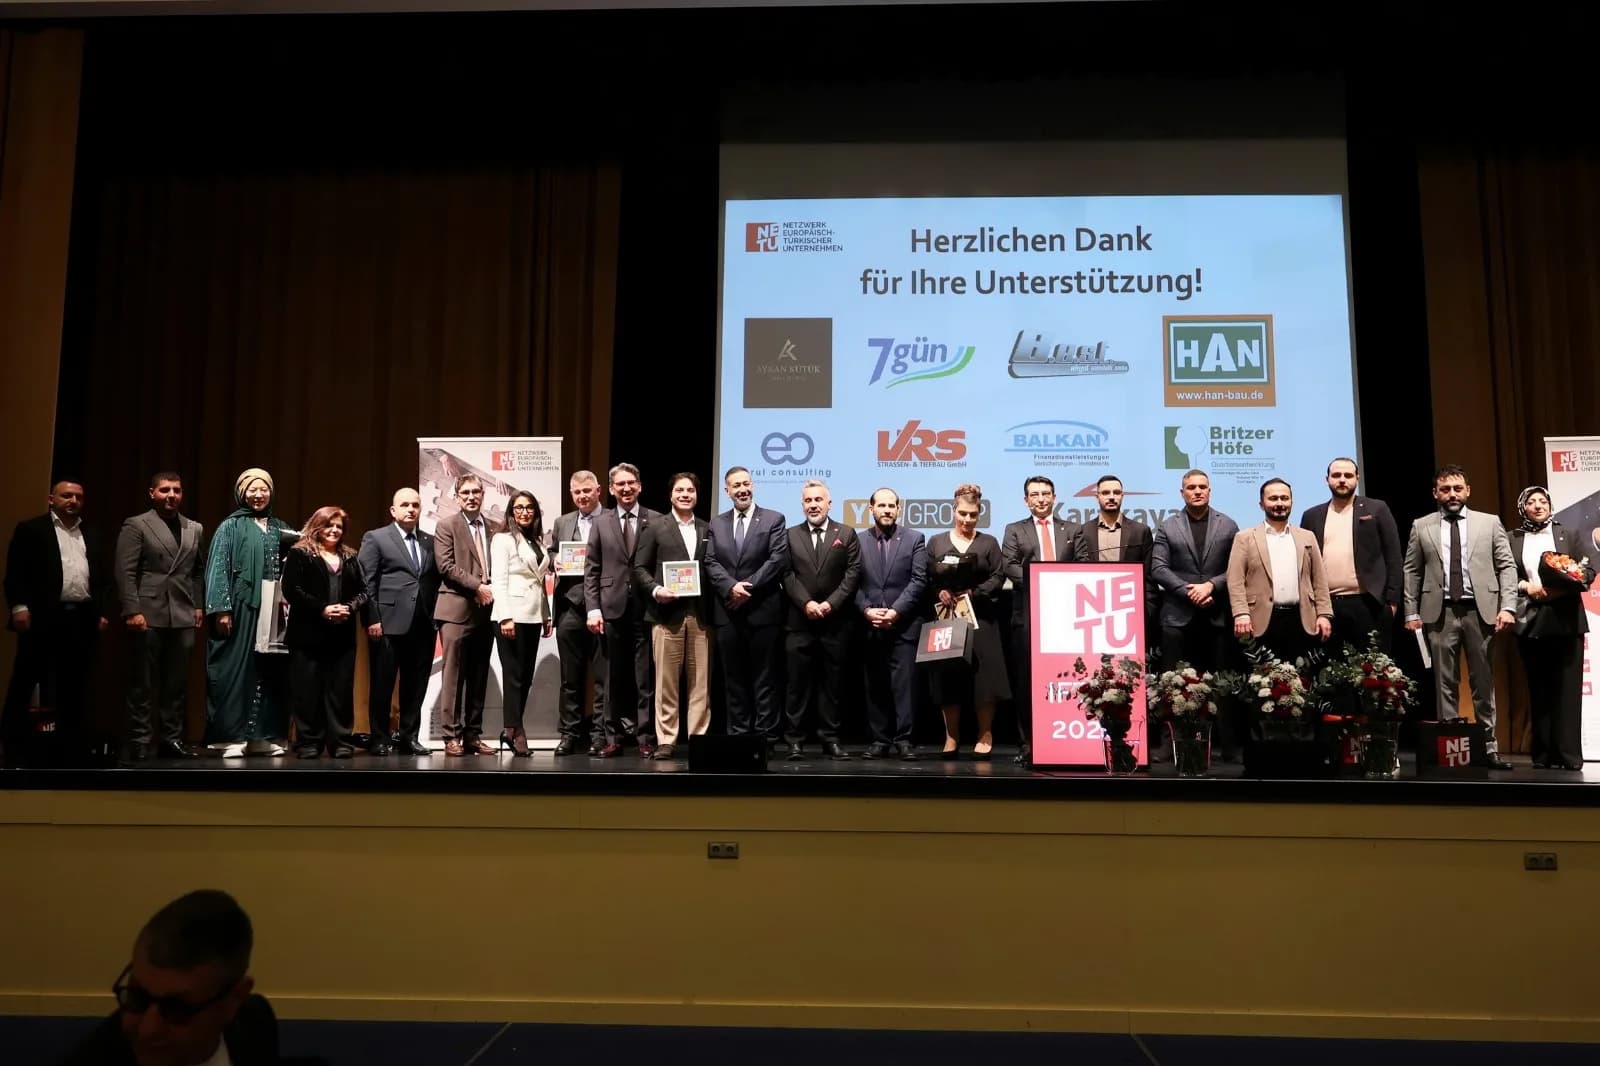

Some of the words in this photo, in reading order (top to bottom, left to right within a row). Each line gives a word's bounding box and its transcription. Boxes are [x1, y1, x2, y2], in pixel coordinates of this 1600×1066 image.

[782, 221, 827, 229] NETZWERK
[910, 226, 1066, 253] Herzlichen
[1075, 225, 1153, 252] Dank
[782, 245, 843, 253] UNTERNEHMEN
[860, 268, 903, 295] für
[910, 268, 968, 295] Ihre
[975, 267, 1203, 302] Unterstützung!
[1176, 332, 1261, 372] HAN
[1176, 390, 1264, 401] www.han-bau.de
[1013, 433, 1102, 448] BALKAN
[1209, 426, 1275, 440] Britzer
[1209, 440, 1254, 455] Höfe
[771, 468, 832, 478] consulting
[908, 502, 986, 526] GROP
[1446, 737, 1471, 754] NE
[1446, 751, 1471, 768] TU
